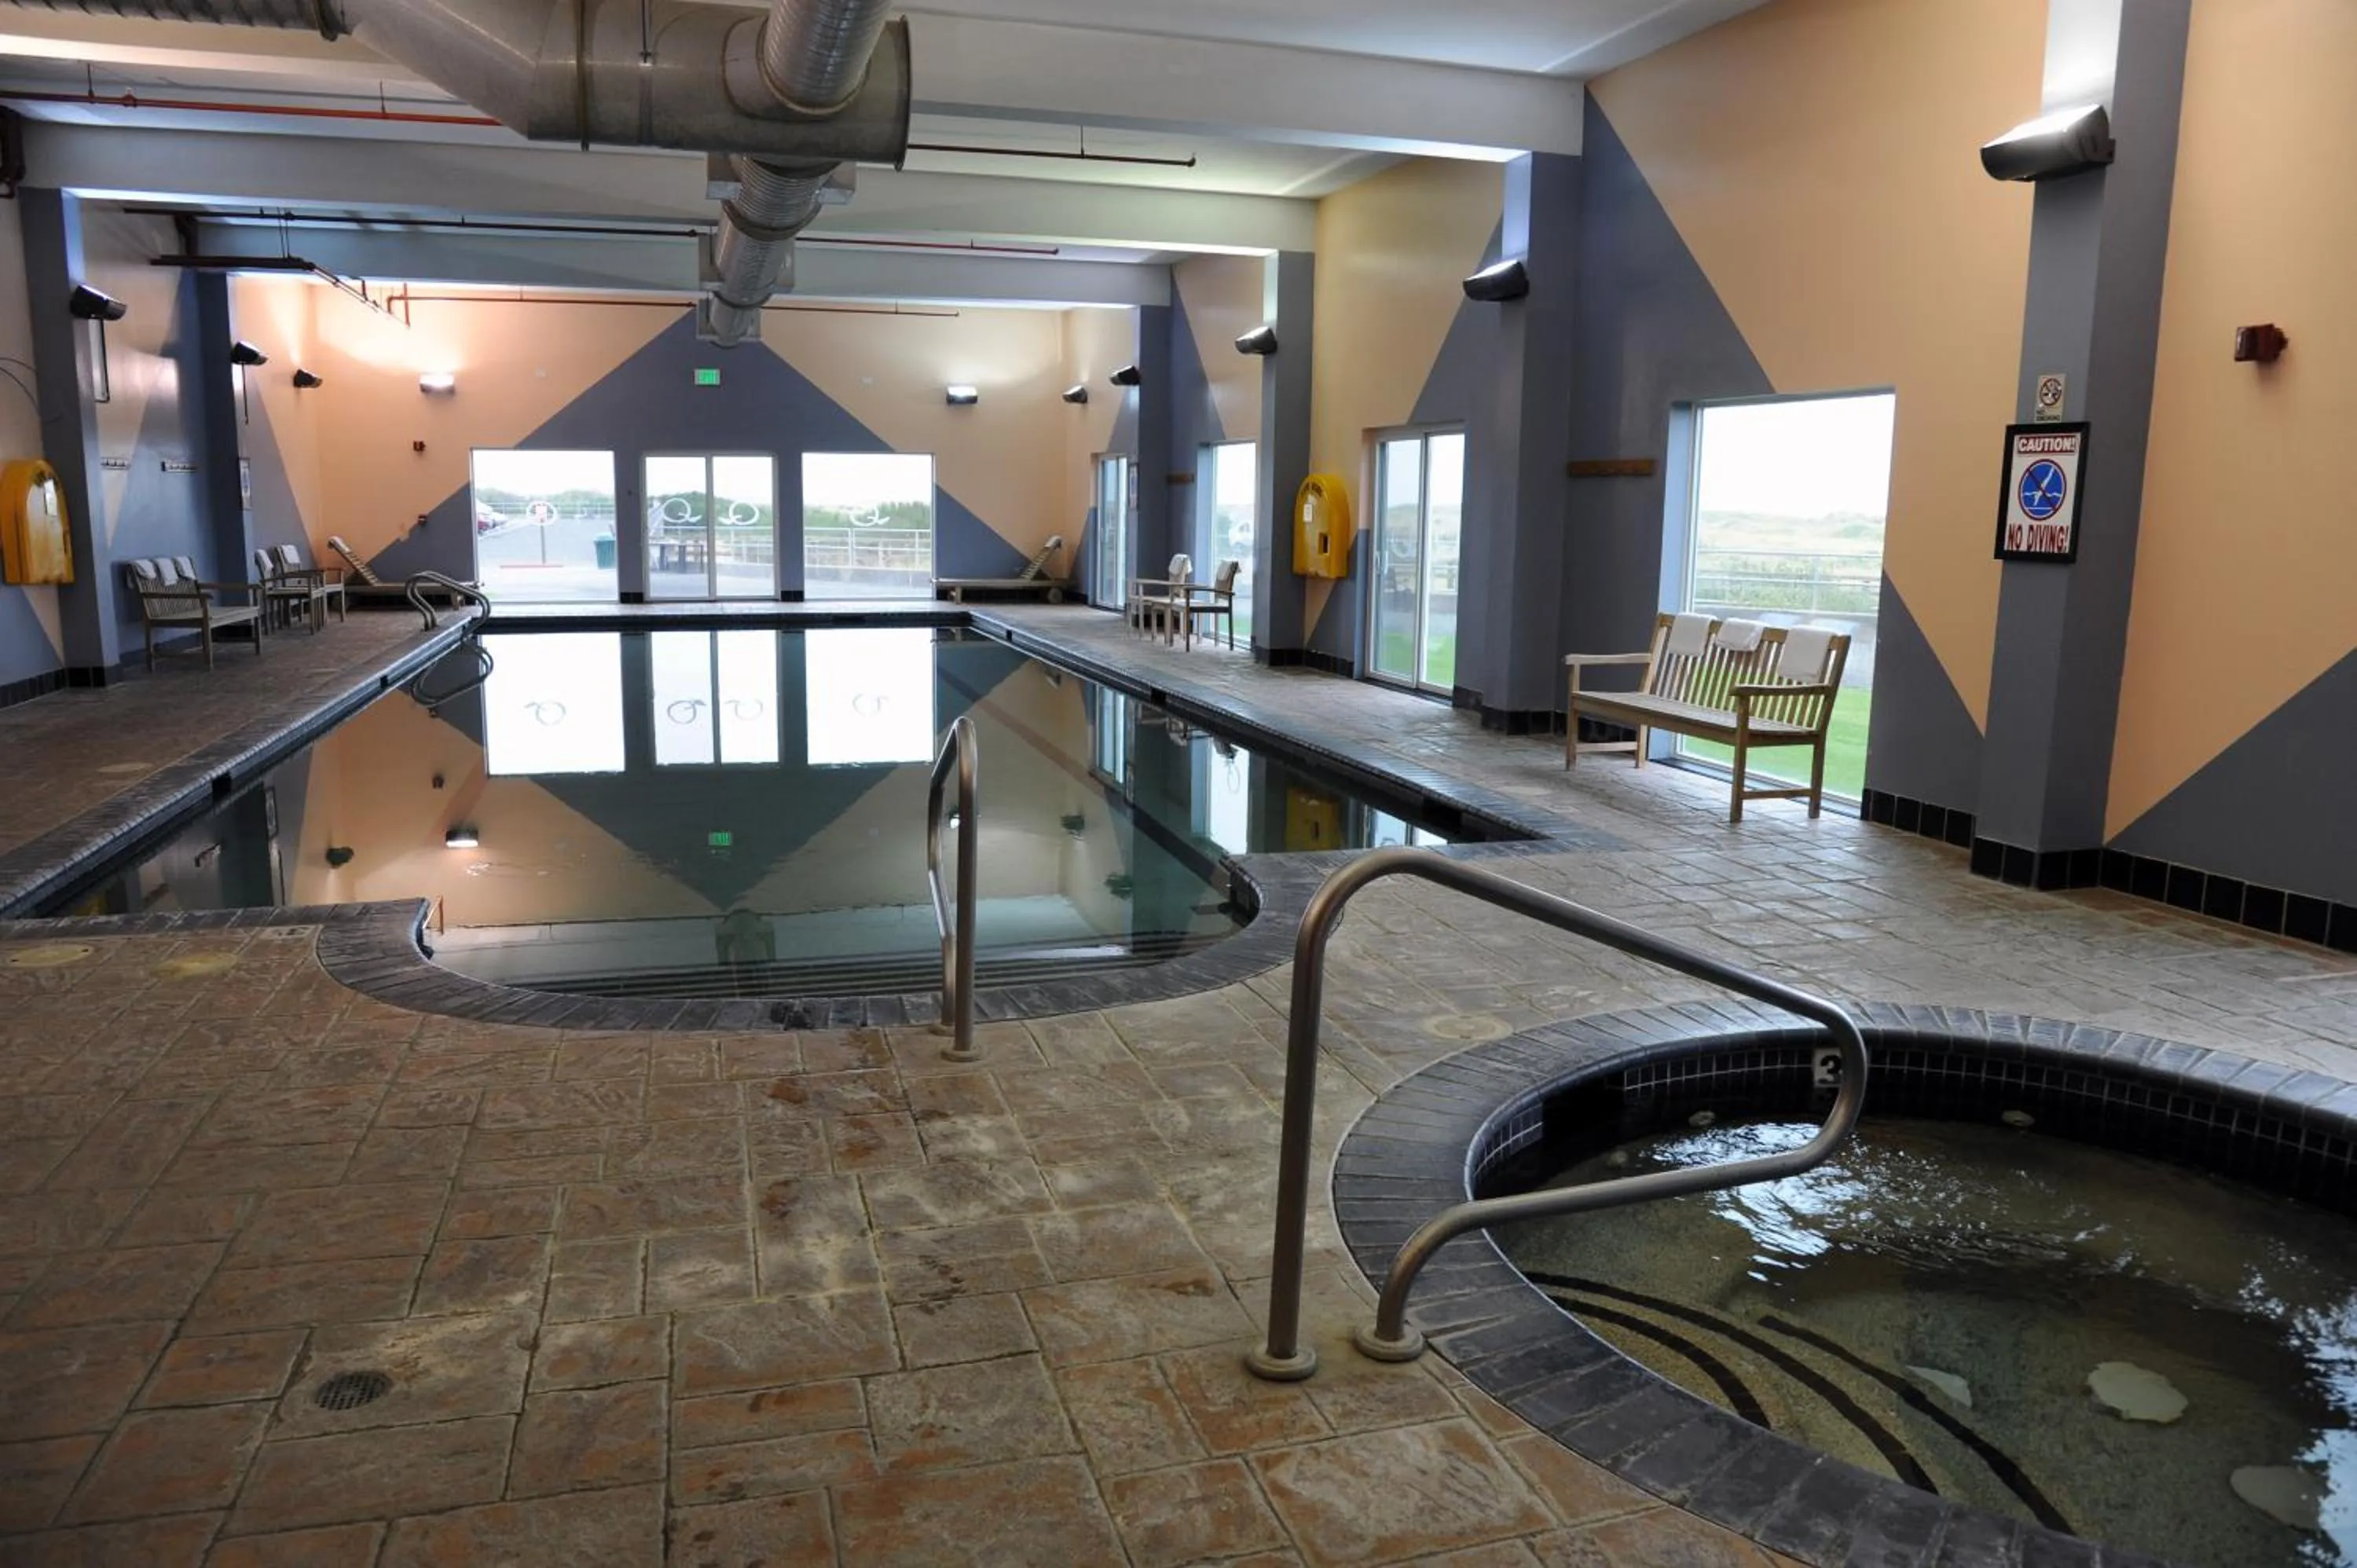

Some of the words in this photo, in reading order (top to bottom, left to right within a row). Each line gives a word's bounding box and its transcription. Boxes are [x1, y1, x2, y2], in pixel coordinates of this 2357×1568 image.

[2018, 437, 2075, 452] CAUTION!
[2007, 524, 2023, 551] NO
[2027, 524, 2069, 552] DIVING!
